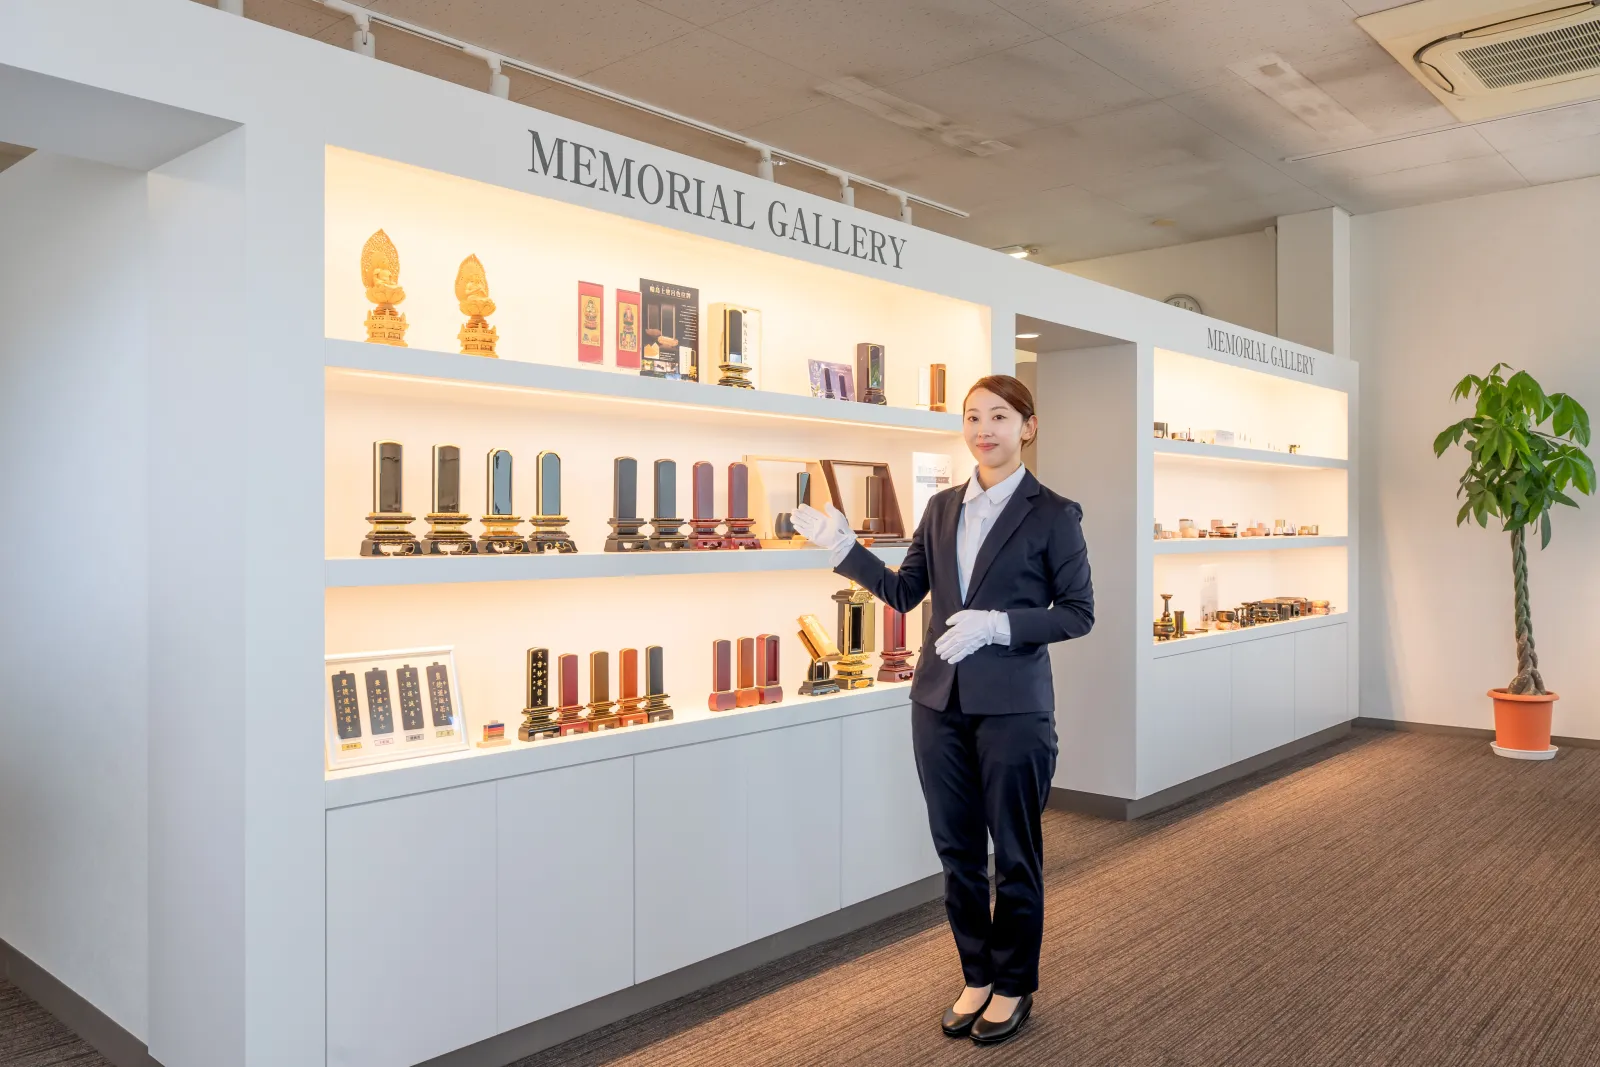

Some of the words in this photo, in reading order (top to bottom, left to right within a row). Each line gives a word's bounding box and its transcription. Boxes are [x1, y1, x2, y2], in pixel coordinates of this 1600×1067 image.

[527, 129, 755, 230] MEMORIAL
[768, 200, 908, 270] GALLERY
[1207, 328, 1269, 363] MEMORIAL
[1271, 346, 1316, 375] GALLERY
